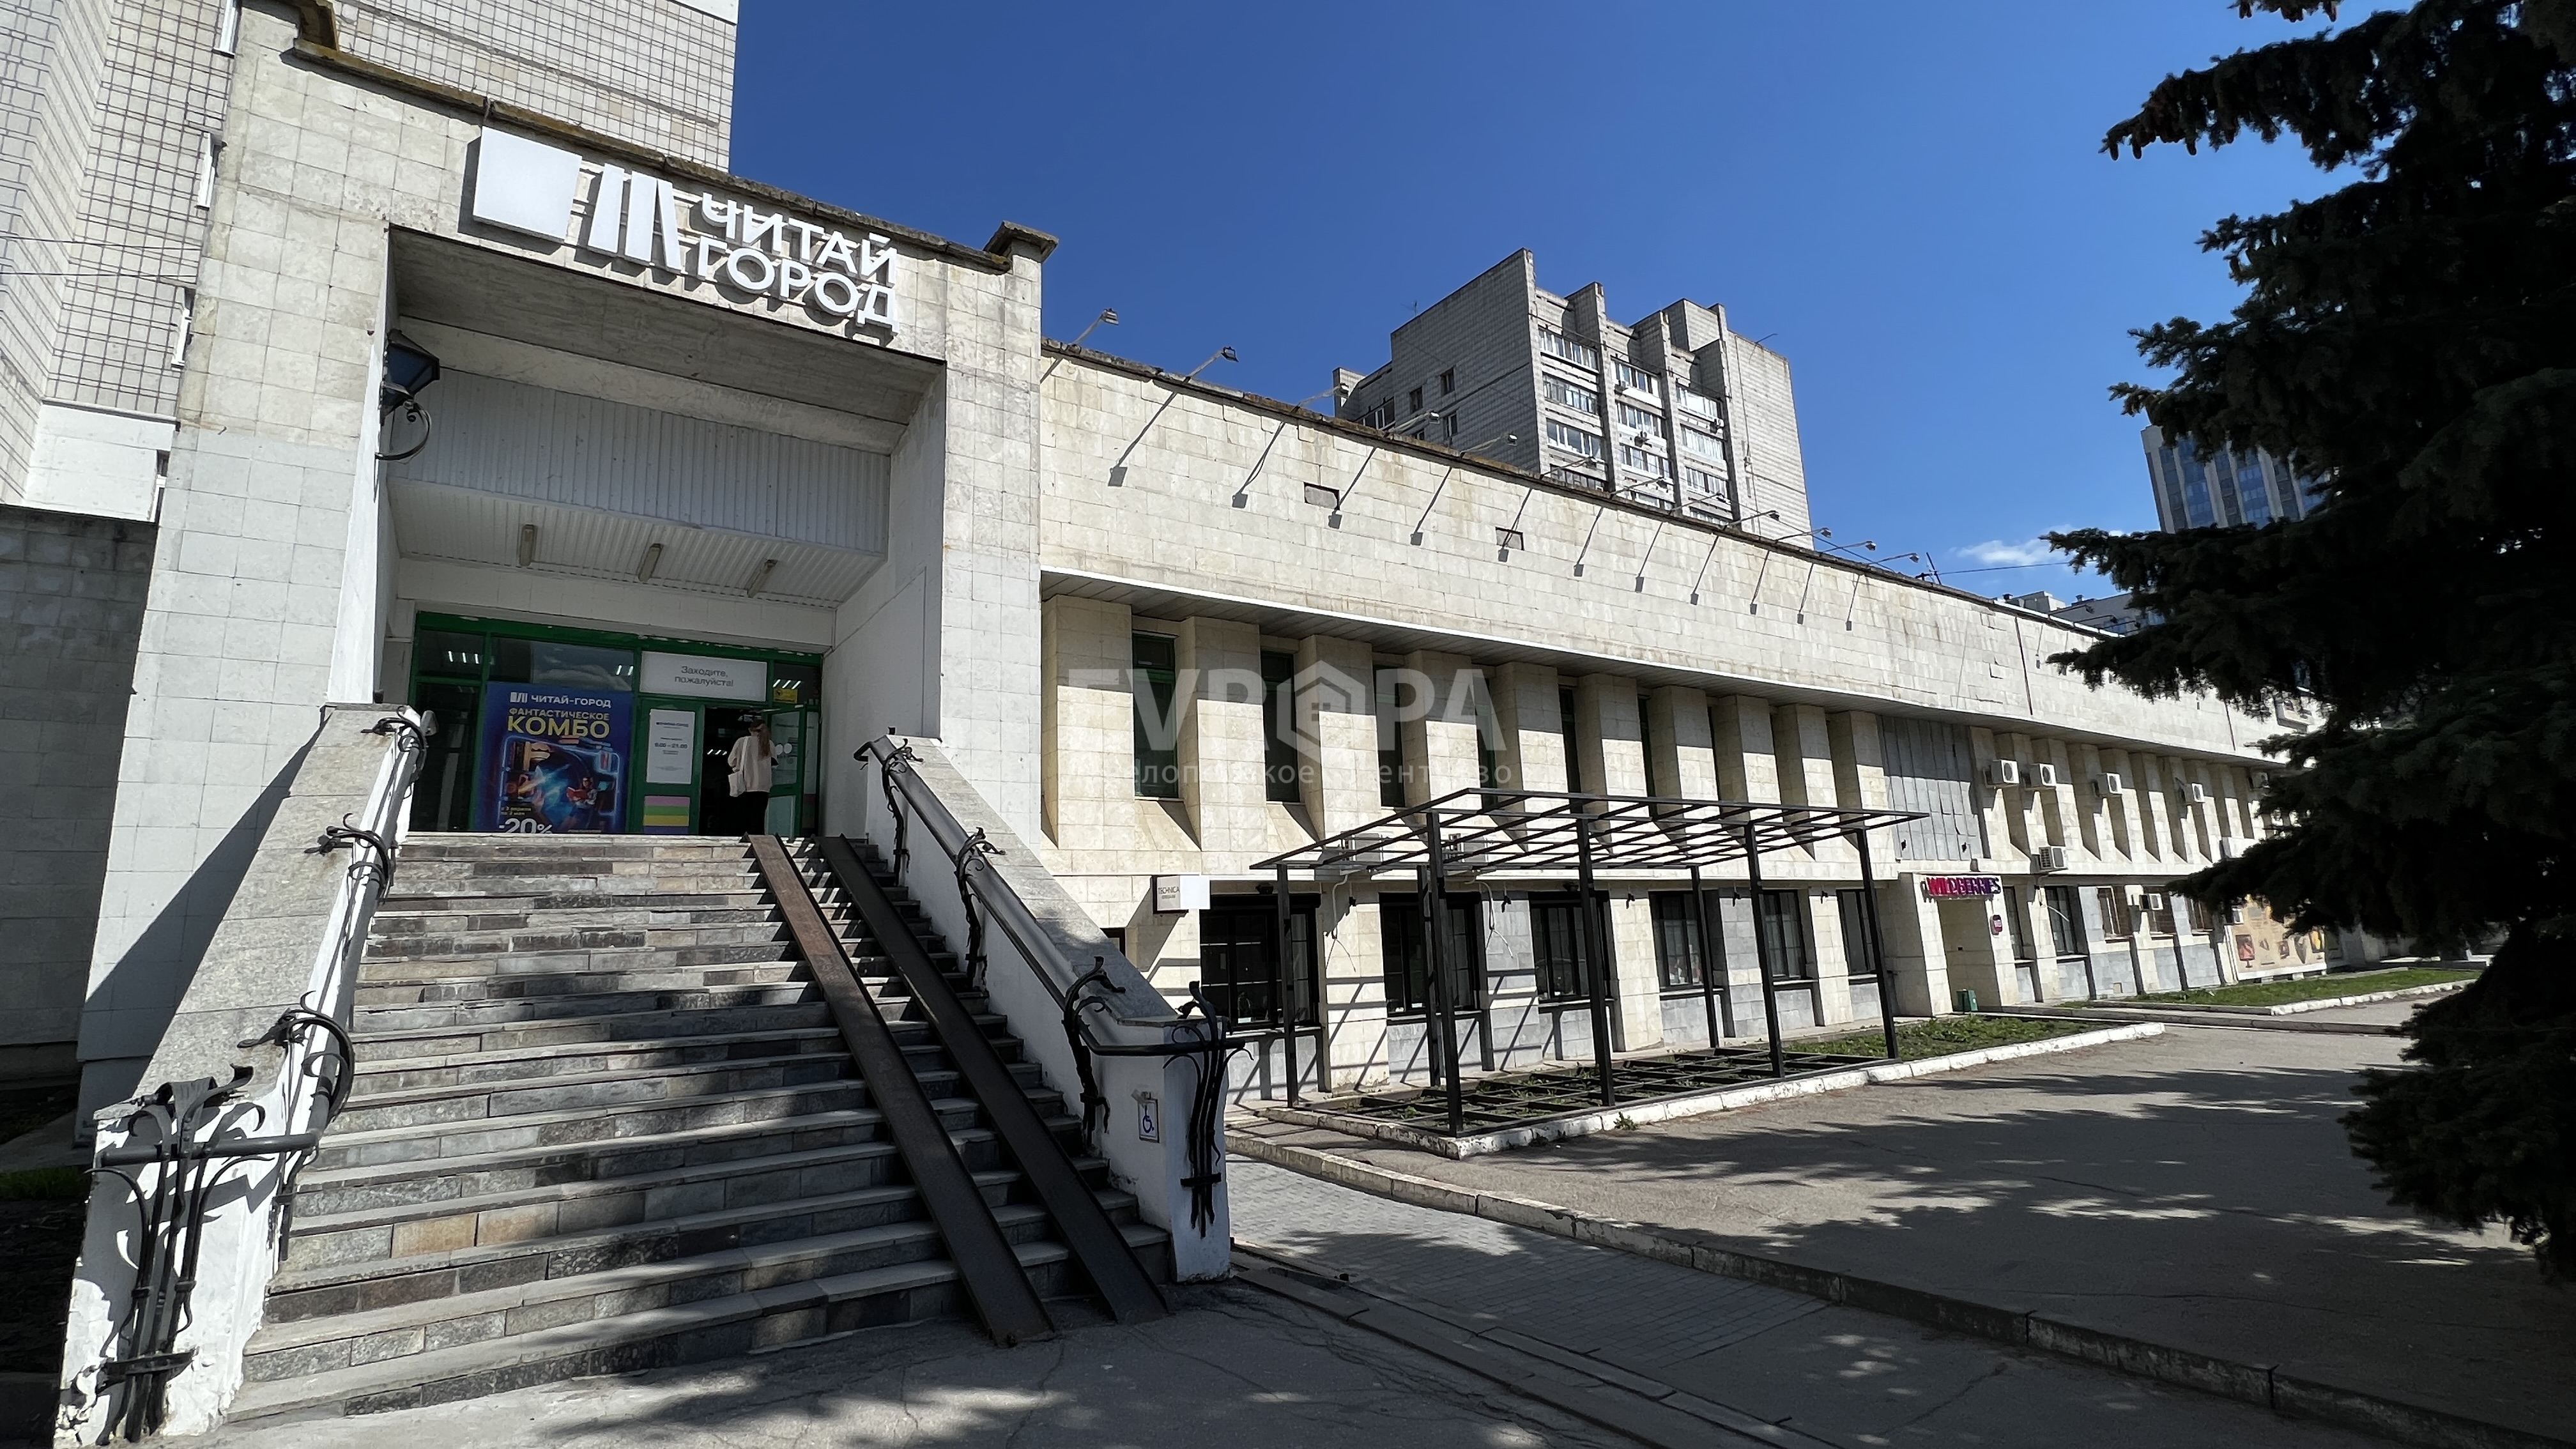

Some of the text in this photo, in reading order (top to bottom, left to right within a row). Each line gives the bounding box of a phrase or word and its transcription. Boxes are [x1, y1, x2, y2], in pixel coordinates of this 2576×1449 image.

[702, 192, 898, 285] ЧИТАЙ
[698, 236, 901, 334] ГОРОД
[681, 666, 728, 677] Заходите,
[675, 676, 733, 687] пожалуйста!
[531, 694, 611, 709] ЧИТАЙ-ГОРОД
[509, 707, 610, 721] ФАНТАСТИЧЕСКОЕ
[507, 716, 610, 739] КОМБО
[498, 818, 553, 834] -20%
[1158, 886, 1180, 894] TECHNICA
